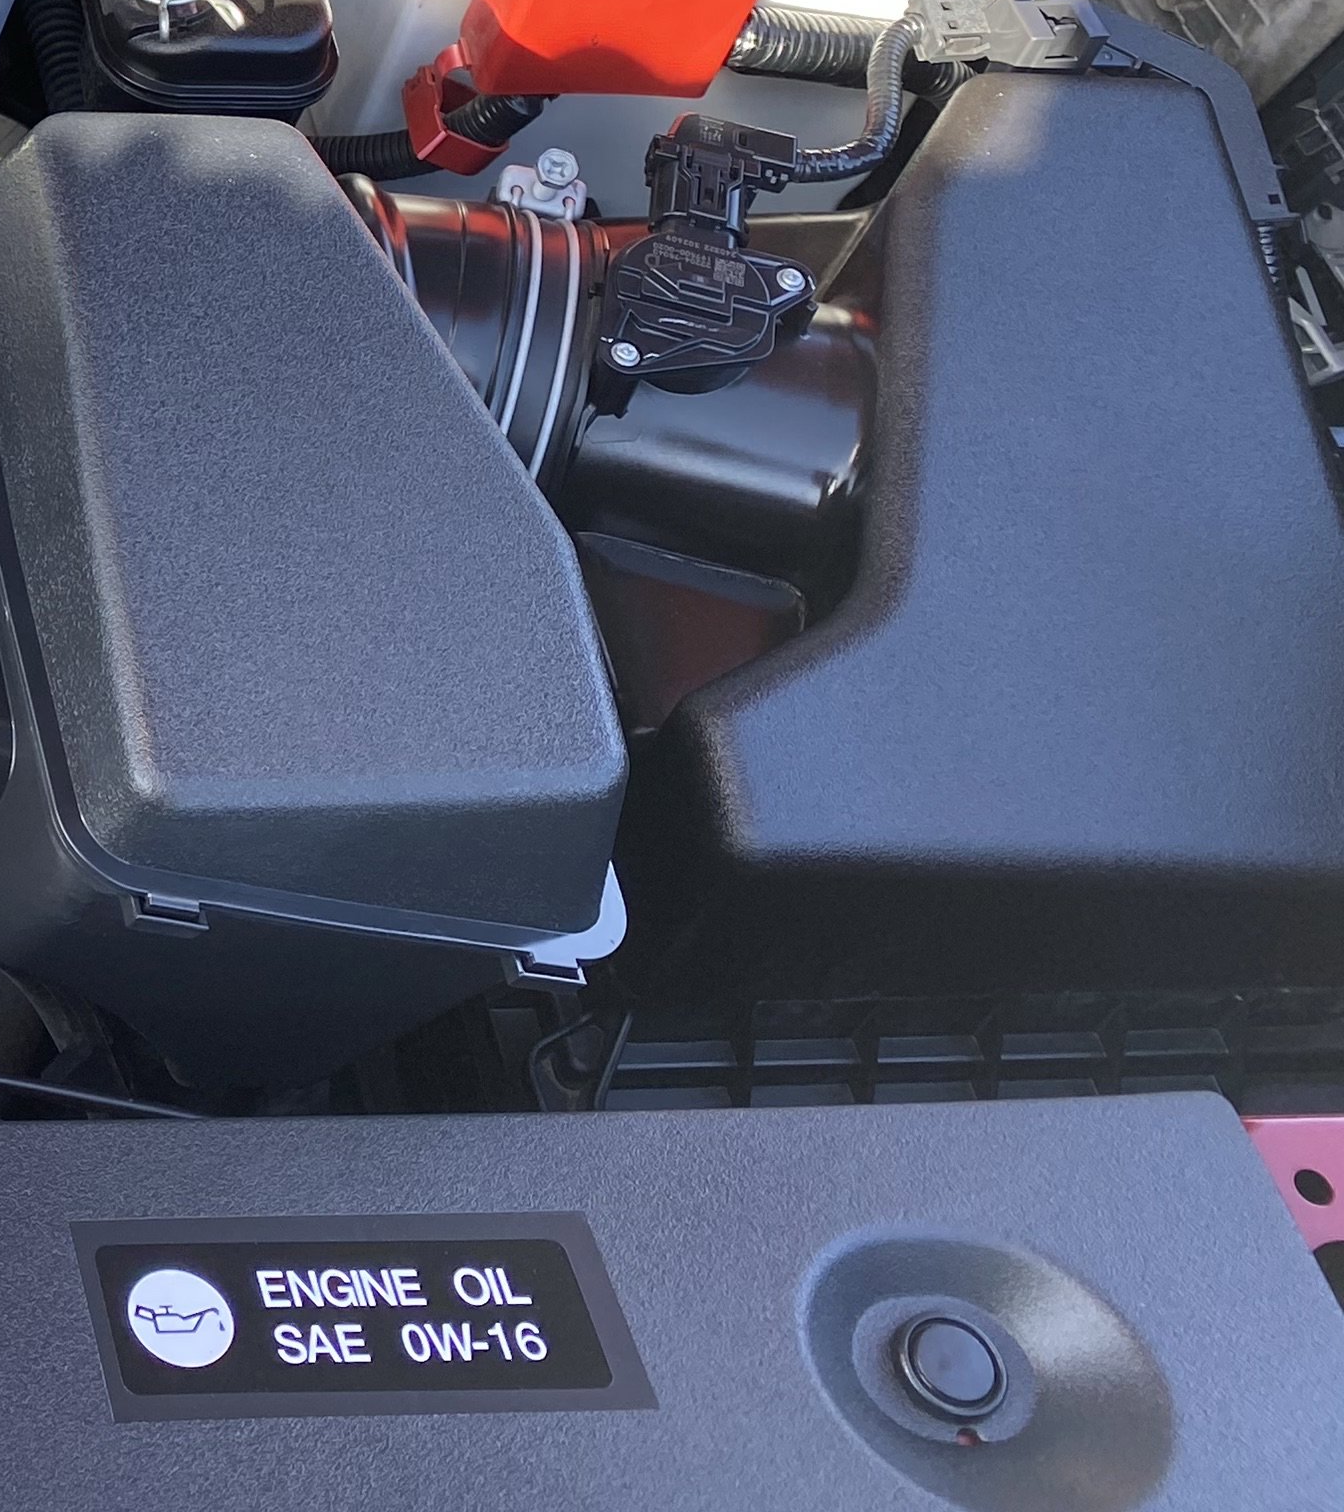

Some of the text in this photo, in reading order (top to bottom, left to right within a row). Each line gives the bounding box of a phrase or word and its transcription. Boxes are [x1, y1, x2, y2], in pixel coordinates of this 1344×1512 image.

[257, 1268, 532, 1308] ENGINE OIL
[275, 1322, 547, 1364] SAE 0W-16
